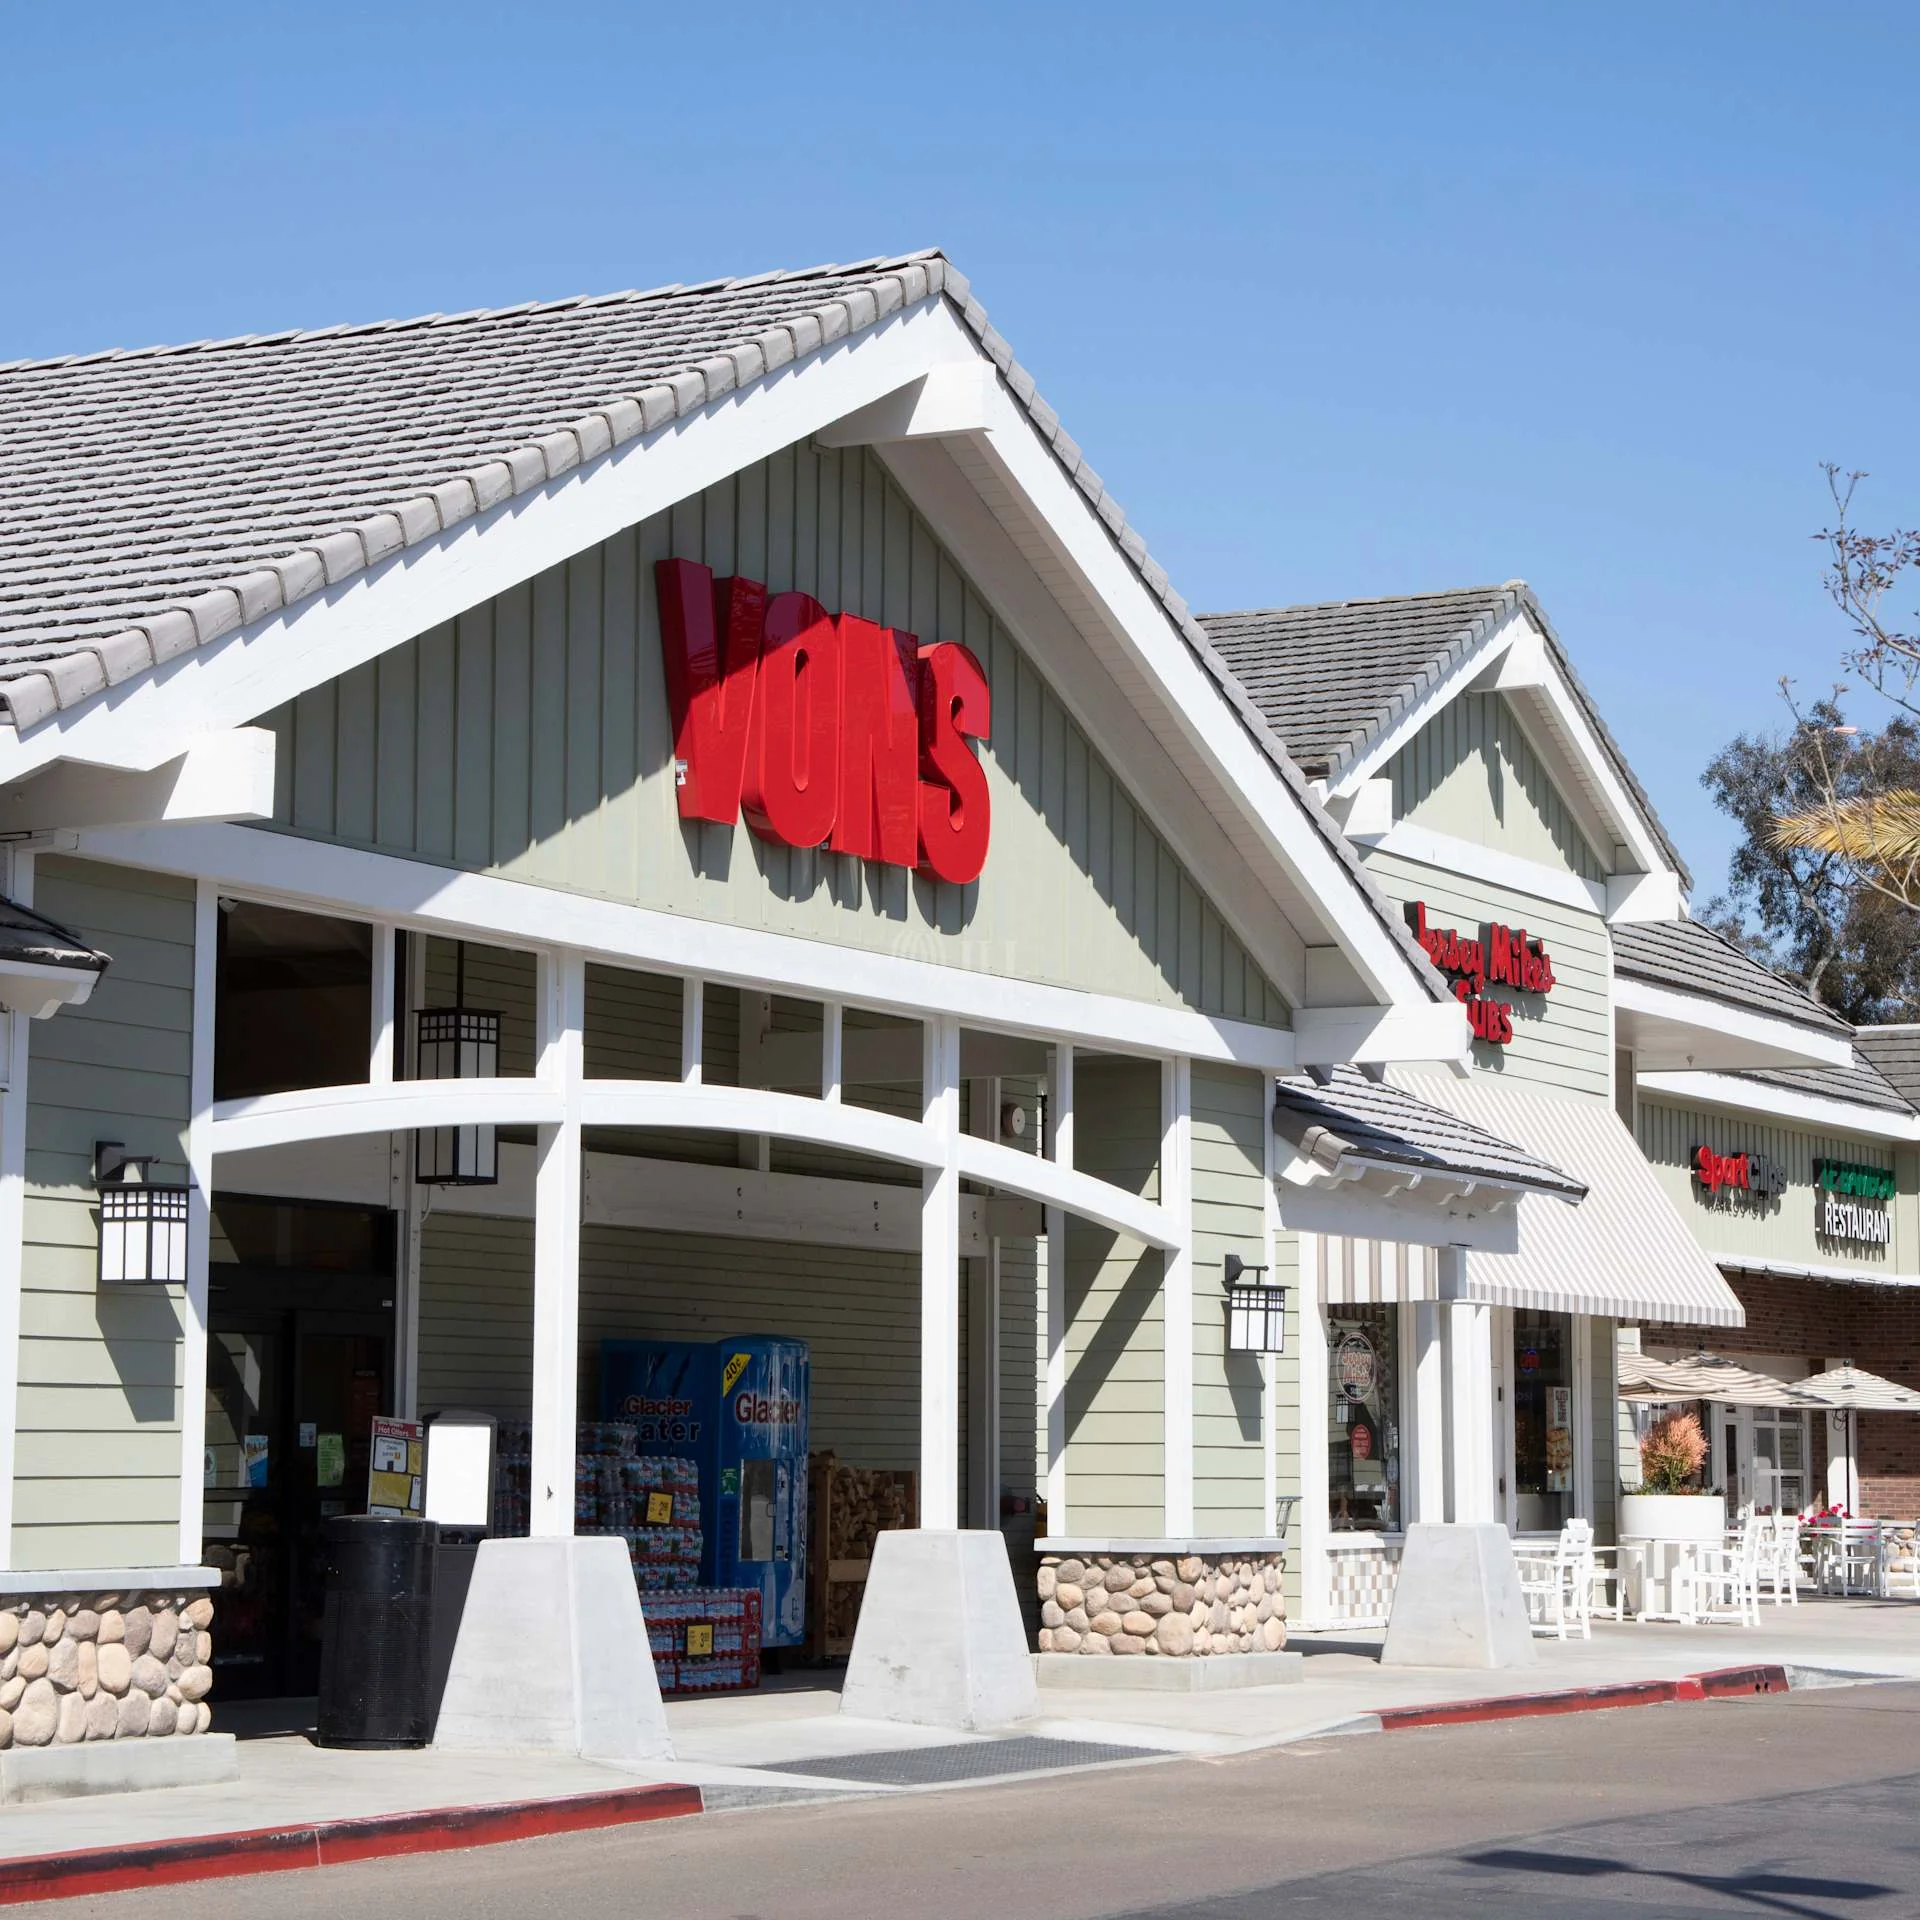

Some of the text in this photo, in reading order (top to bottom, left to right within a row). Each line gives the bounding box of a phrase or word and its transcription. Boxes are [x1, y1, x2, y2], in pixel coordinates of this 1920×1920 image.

[656, 557, 991, 885] VONS
[1414, 900, 1486, 994] Jersey
[1696, 1144, 1788, 1199] Sport Clips
[1824, 1201, 1893, 1245] RESTAURANT
[624, 1395, 692, 1417] Glacier
[735, 1392, 801, 1425] Glacier
